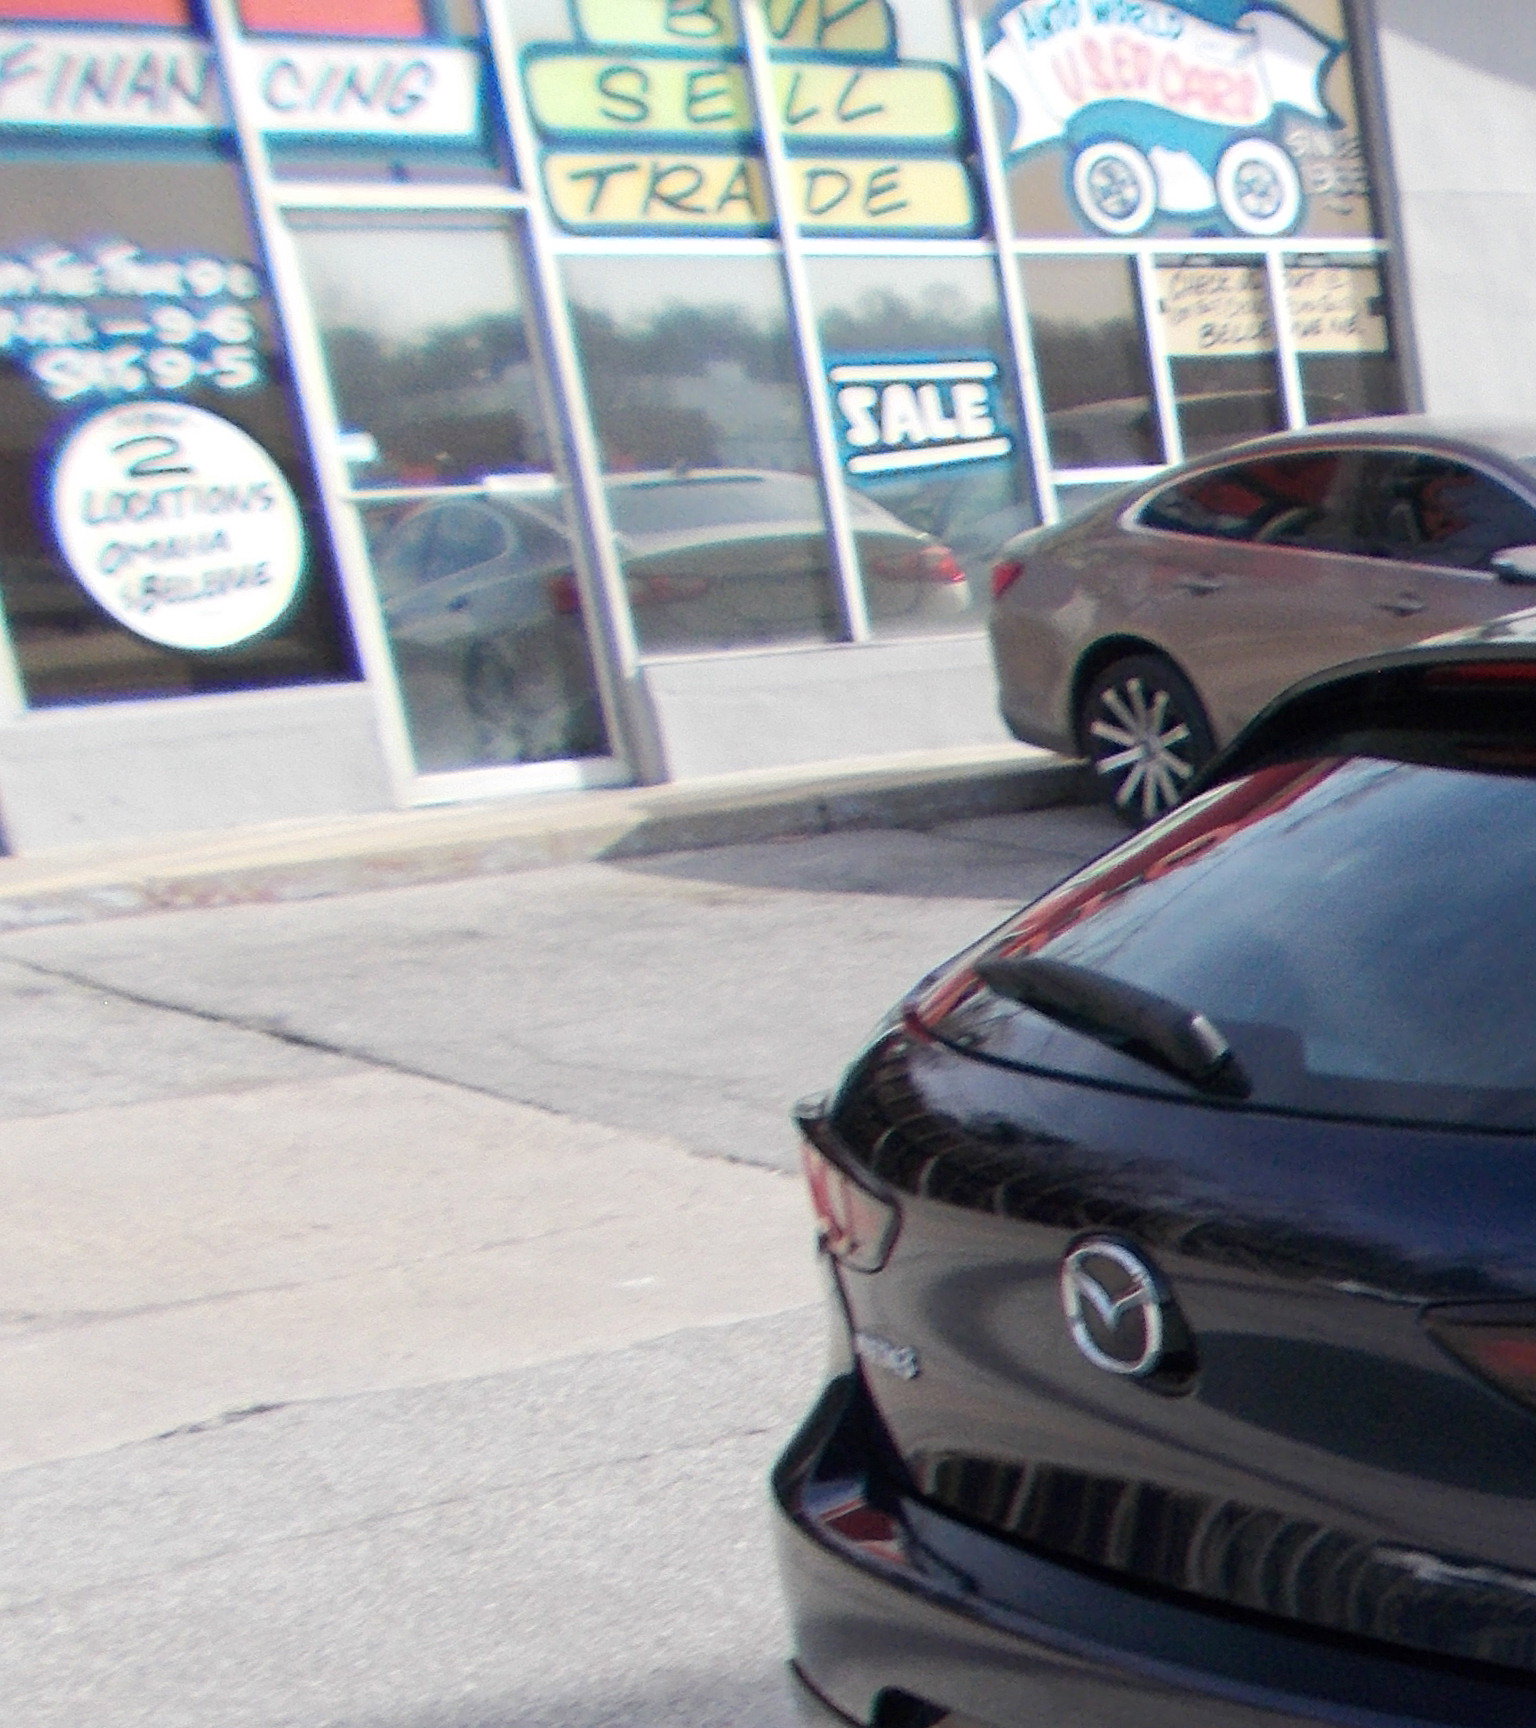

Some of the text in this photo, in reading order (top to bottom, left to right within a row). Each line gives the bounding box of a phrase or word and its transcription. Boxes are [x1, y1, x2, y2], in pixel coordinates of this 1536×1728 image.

[597, 64, 884, 125] SELL
[567, 158, 909, 217] TRADE
[837, 382, 997, 448] SALE
[108, 433, 195, 479] 2
[82, 481, 274, 526] LOCATIONS
